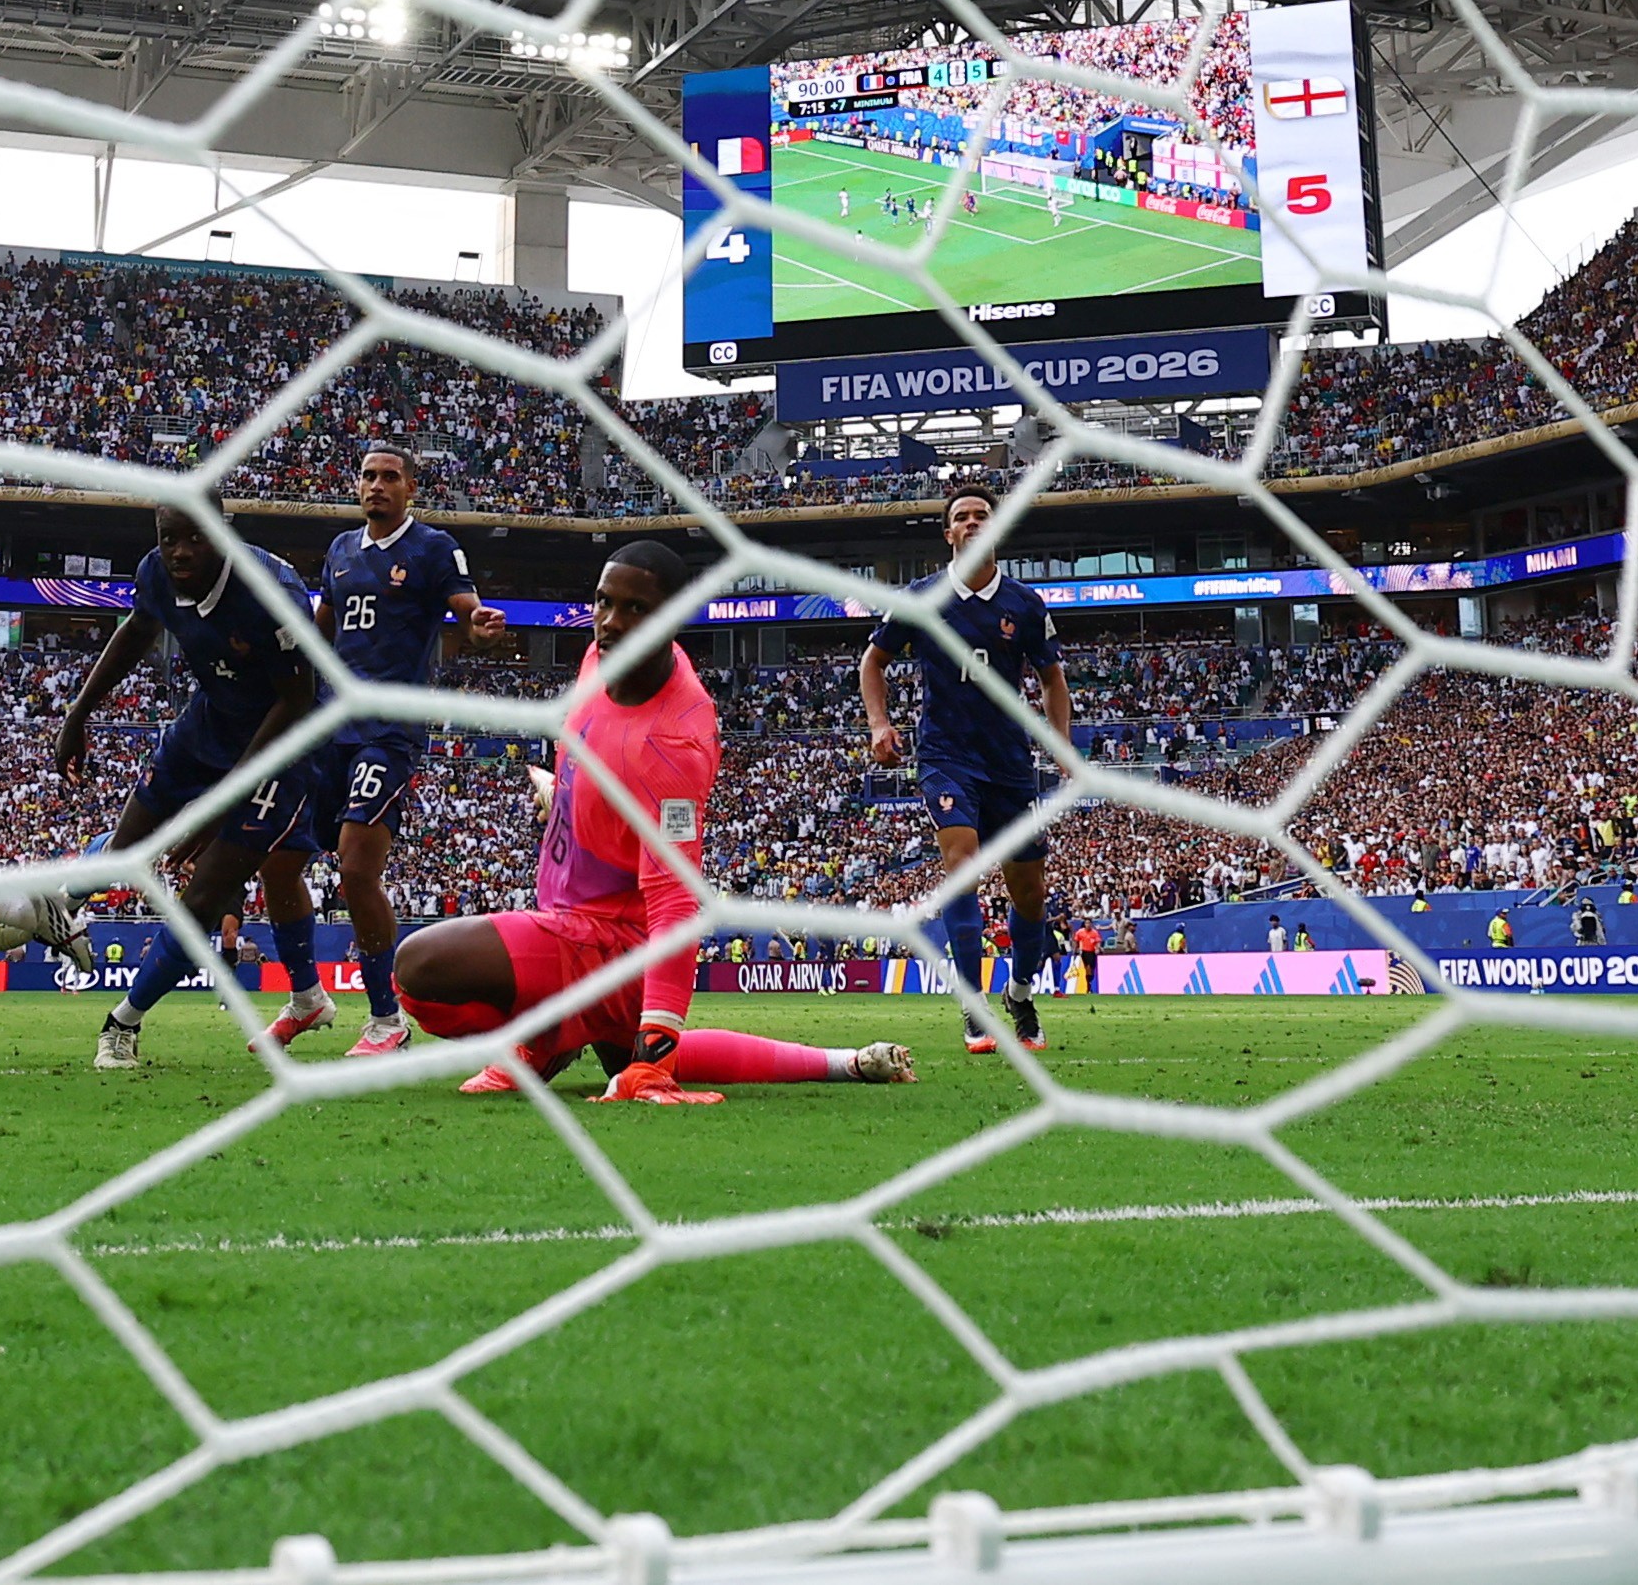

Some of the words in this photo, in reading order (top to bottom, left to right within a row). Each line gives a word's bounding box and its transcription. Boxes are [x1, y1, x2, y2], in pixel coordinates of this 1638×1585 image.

[798, 79, 845, 98] 90:00
[899, 69, 923, 86] FRA
[933, 70, 943, 83] 4
[972, 65, 982, 79] 5
[798, 102, 826, 116] 7:15
[830, 99, 847, 112] +7
[853, 96, 894, 110] MINIMUM
[1286, 174, 1332, 215] 5
[706, 225, 750, 264] 4
[968, 298, 1056, 323] Hisense
[712, 346, 734, 361] CC
[821, 372, 891, 403] FIFA
[894, 364, 1013, 398] WORLD
[1024, 358, 1091, 389] CUP
[1097, 348, 1220, 383] 2026
[1525, 545, 1579, 575] MIAMI
[1079, 582, 1146, 602] FINAL
[1193, 575, 1283, 597] #FIFAWorldCup
[342, 594, 378, 632] 26
[707, 599, 777, 621] MIAMI
[348, 761, 388, 799] 26
[250, 777, 280, 821] 4
[737, 963, 783, 993] QATAR
[787, 962, 847, 992] AIRWYS
[1438, 958, 1483, 986] FIFA
[1482, 958, 1558, 986] WORLD
[1560, 956, 1604, 985] CUP
